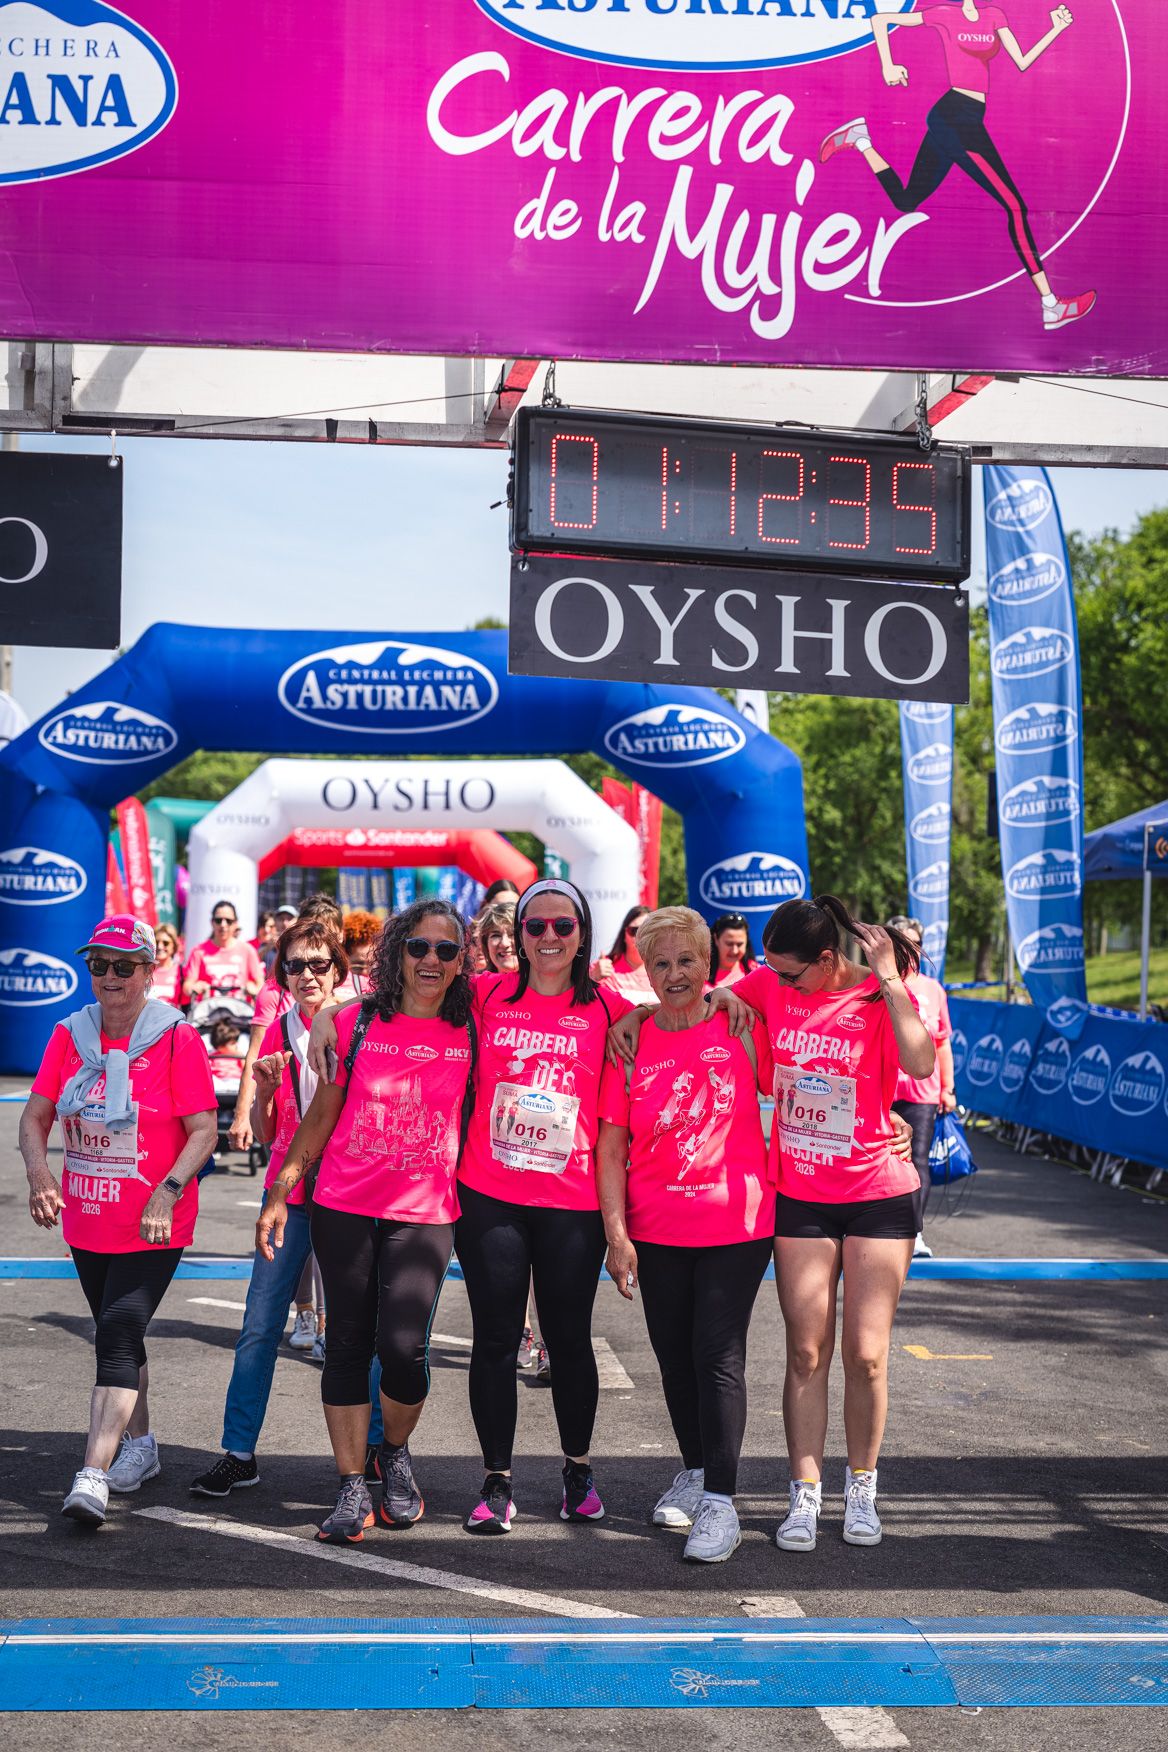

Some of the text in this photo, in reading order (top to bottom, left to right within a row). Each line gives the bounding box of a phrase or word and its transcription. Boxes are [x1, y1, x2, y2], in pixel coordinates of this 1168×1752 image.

[957, 31, 995, 45] OYSHO
[0, 37, 121, 58] CHERA
[0, 71, 138, 127] ANA
[426, 51, 795, 167] Carrera
[514, 159, 931, 340] de la Mujer
[549, 434, 938, 555] 01:12:35
[0, 516, 49, 584] O
[534, 577, 948, 685] OYSHO
[328, 668, 475, 681] CENTRAL LECHERA
[296, 669, 481, 711] ASTURIANA
[47, 720, 166, 751] ASTURIANA
[617, 730, 738, 755] ASTURIANA
[321, 777, 496, 813] OYSHO
[367, 828, 448, 847] Santander
[495, 1011, 532, 1021] OYSHO
[640, 1059, 676, 1075] OYSHO
[797, 1081, 830, 1093] ASTURIANA
[521, 1098, 554, 1111] ASTURIANA
[795, 1106, 827, 1123] 016
[515, 1123, 548, 1141] 016
[802, 1122, 818, 1130] 2018
[84, 1134, 111, 1148] 016
[521, 1139, 538, 1148] 2017
[793, 1161, 815, 1176] 2026
[68, 1175, 121, 1203] MUJER
[81, 1202, 101, 1215] 2026
